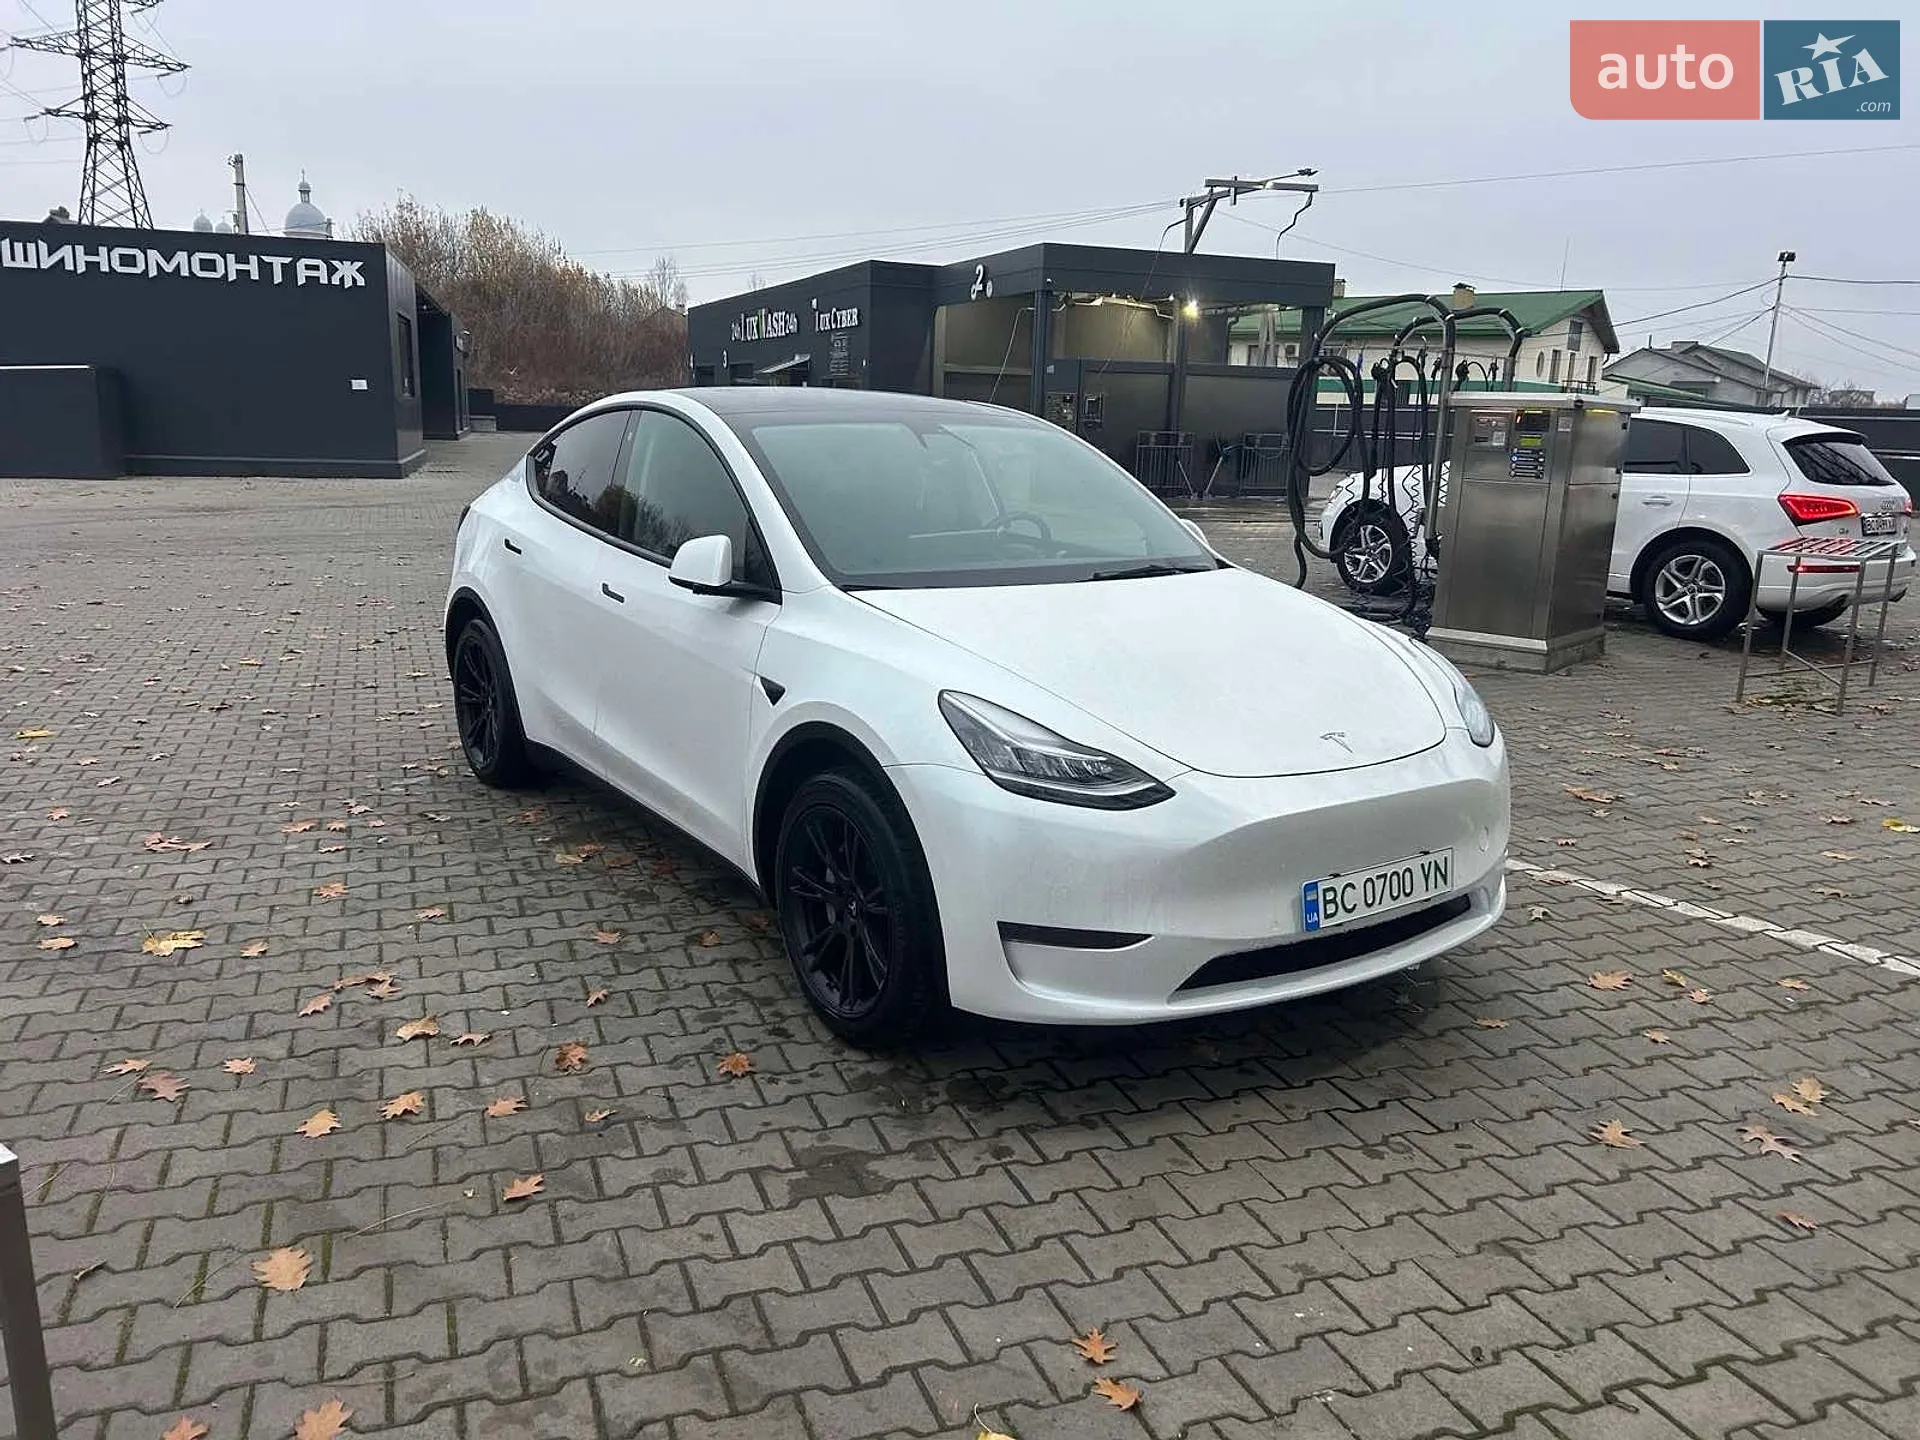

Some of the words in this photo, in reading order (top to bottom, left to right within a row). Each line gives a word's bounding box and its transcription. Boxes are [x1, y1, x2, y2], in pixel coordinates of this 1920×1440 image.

[1, 237, 366, 289] ШИНОМОНТАЖ
[722, 350, 728, 369] 3
[1322, 882, 1357, 920] BC
[1363, 867, 1414, 908] 0700
[1420, 856, 1448, 892] YN
[1306, 913, 1319, 924] UA
